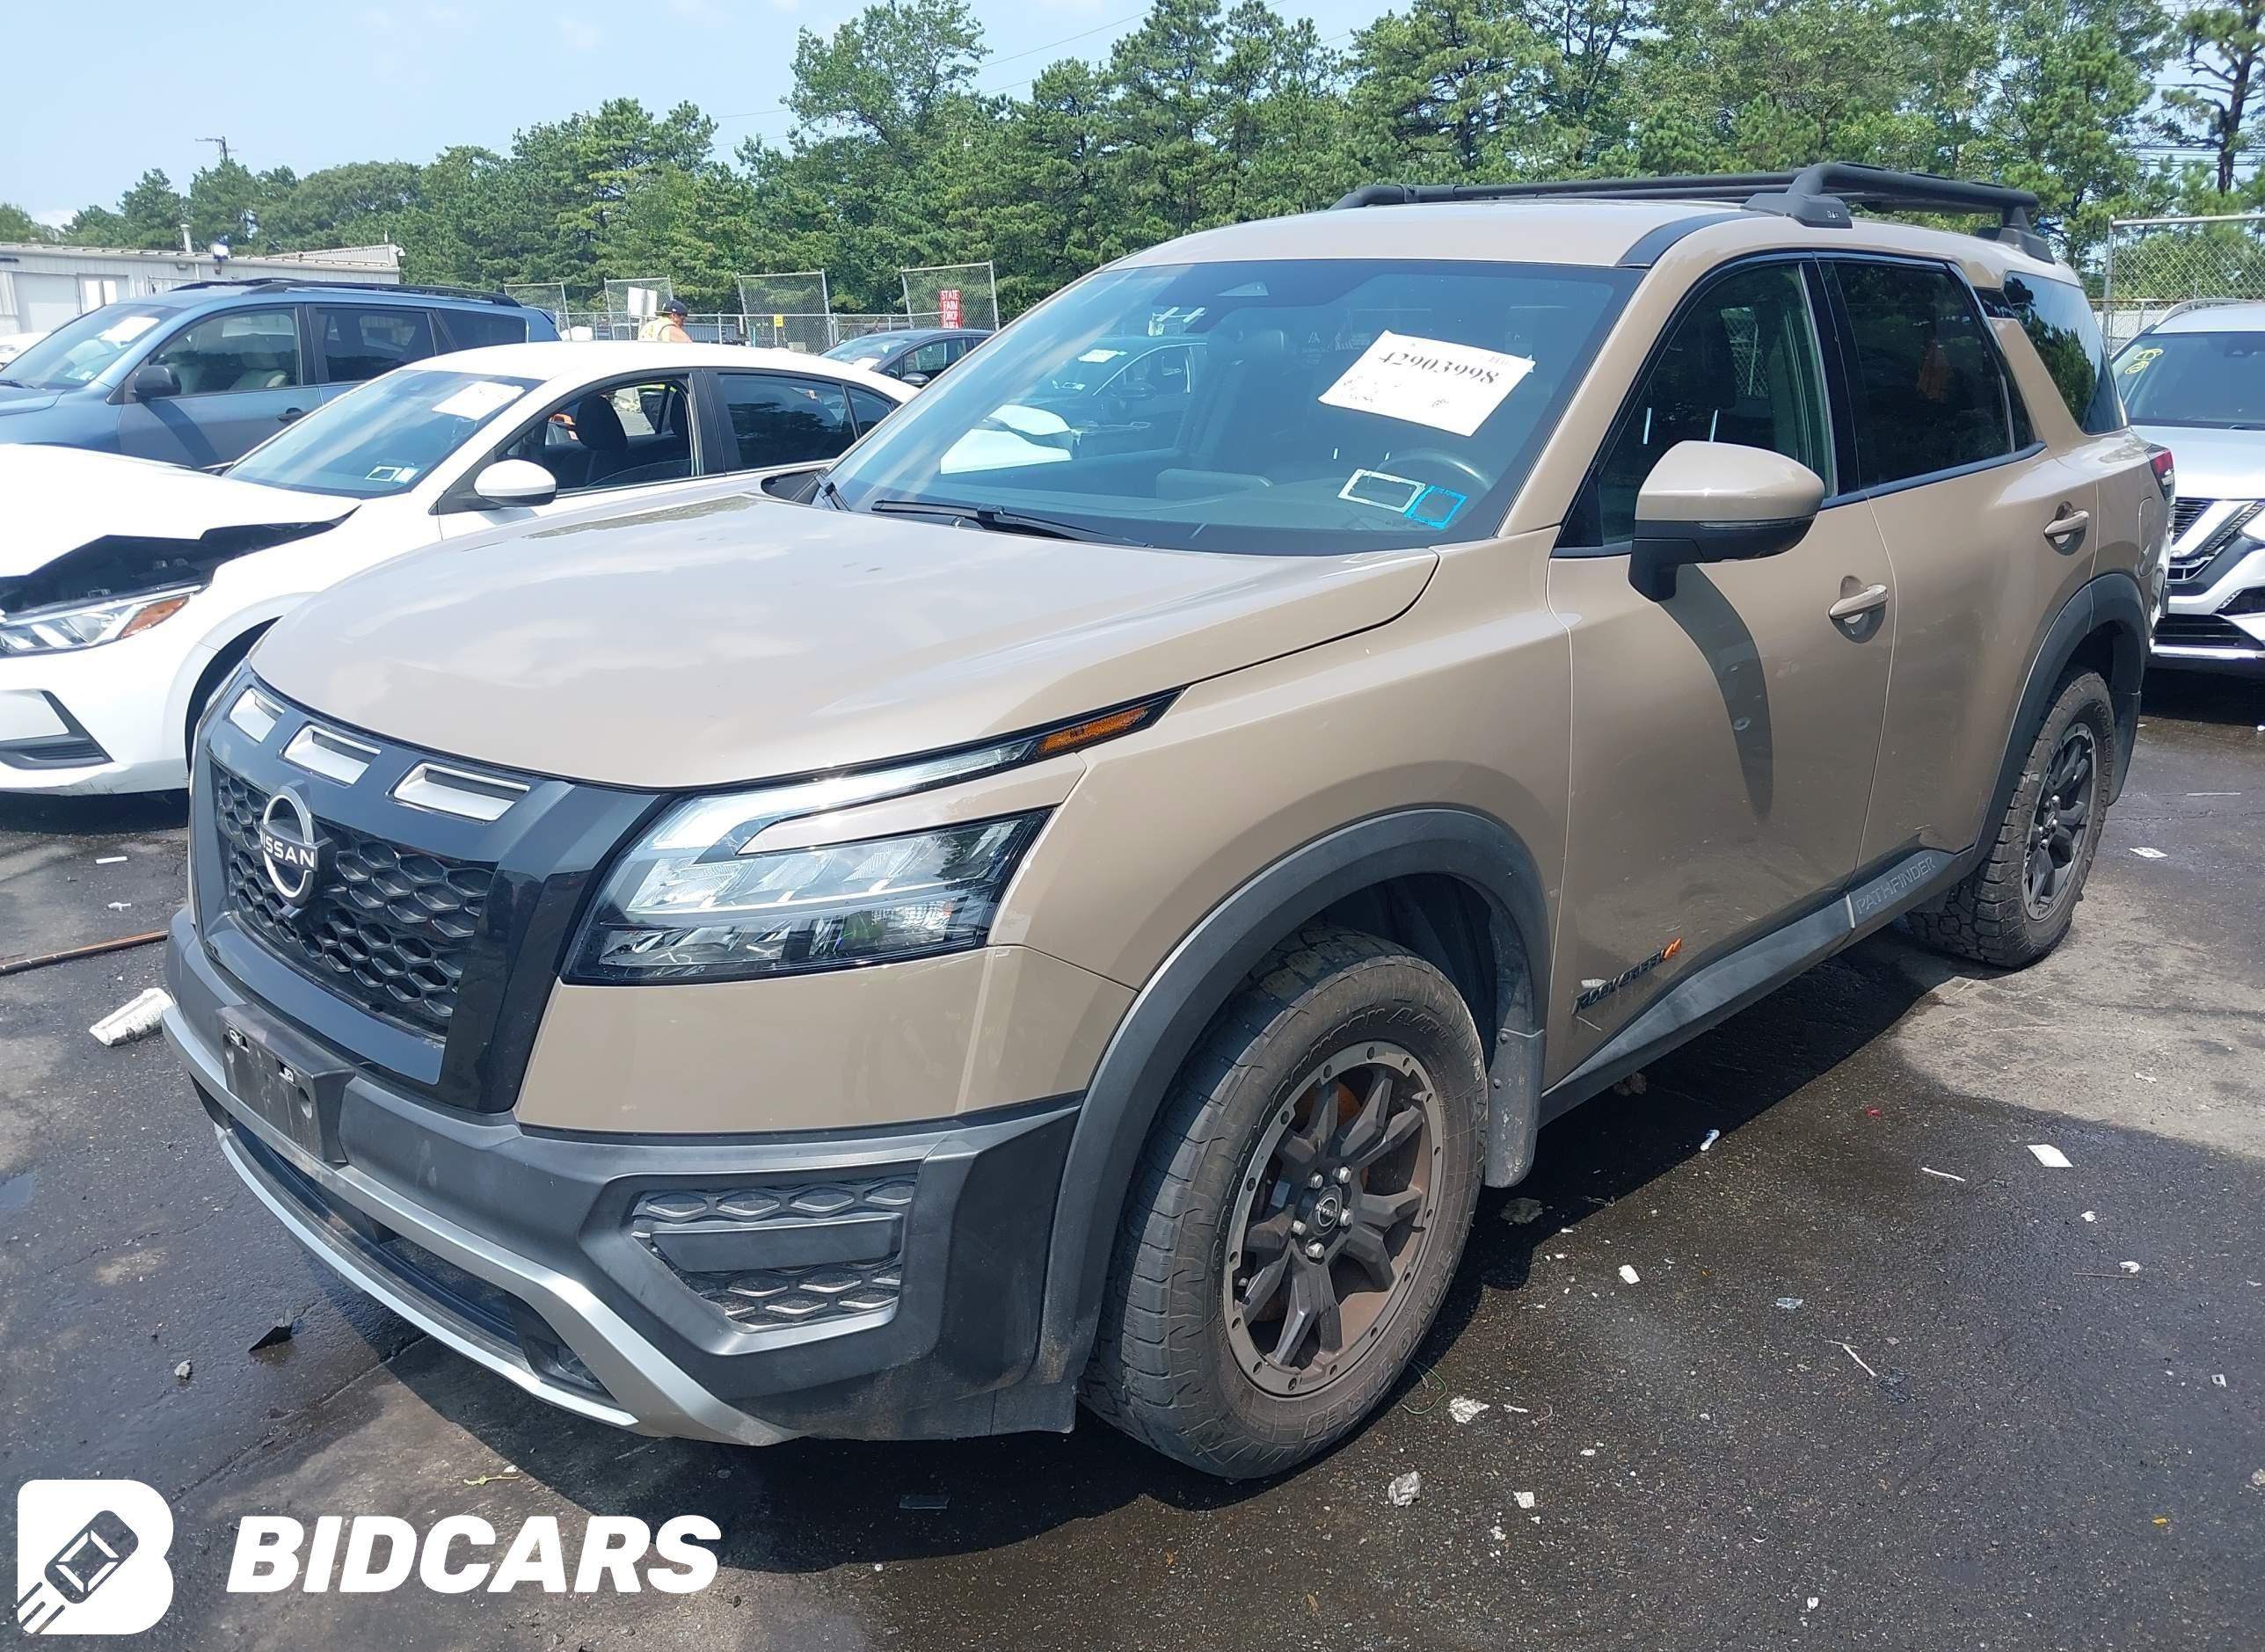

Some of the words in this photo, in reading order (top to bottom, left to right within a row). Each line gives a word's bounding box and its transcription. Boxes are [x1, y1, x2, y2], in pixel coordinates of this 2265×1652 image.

[941, 289, 959, 301] STATE
[1378, 351, 1499, 384] 42903998
[259, 826, 315, 868] NISSAN
[1855, 856, 1937, 915] PATHFINDER
